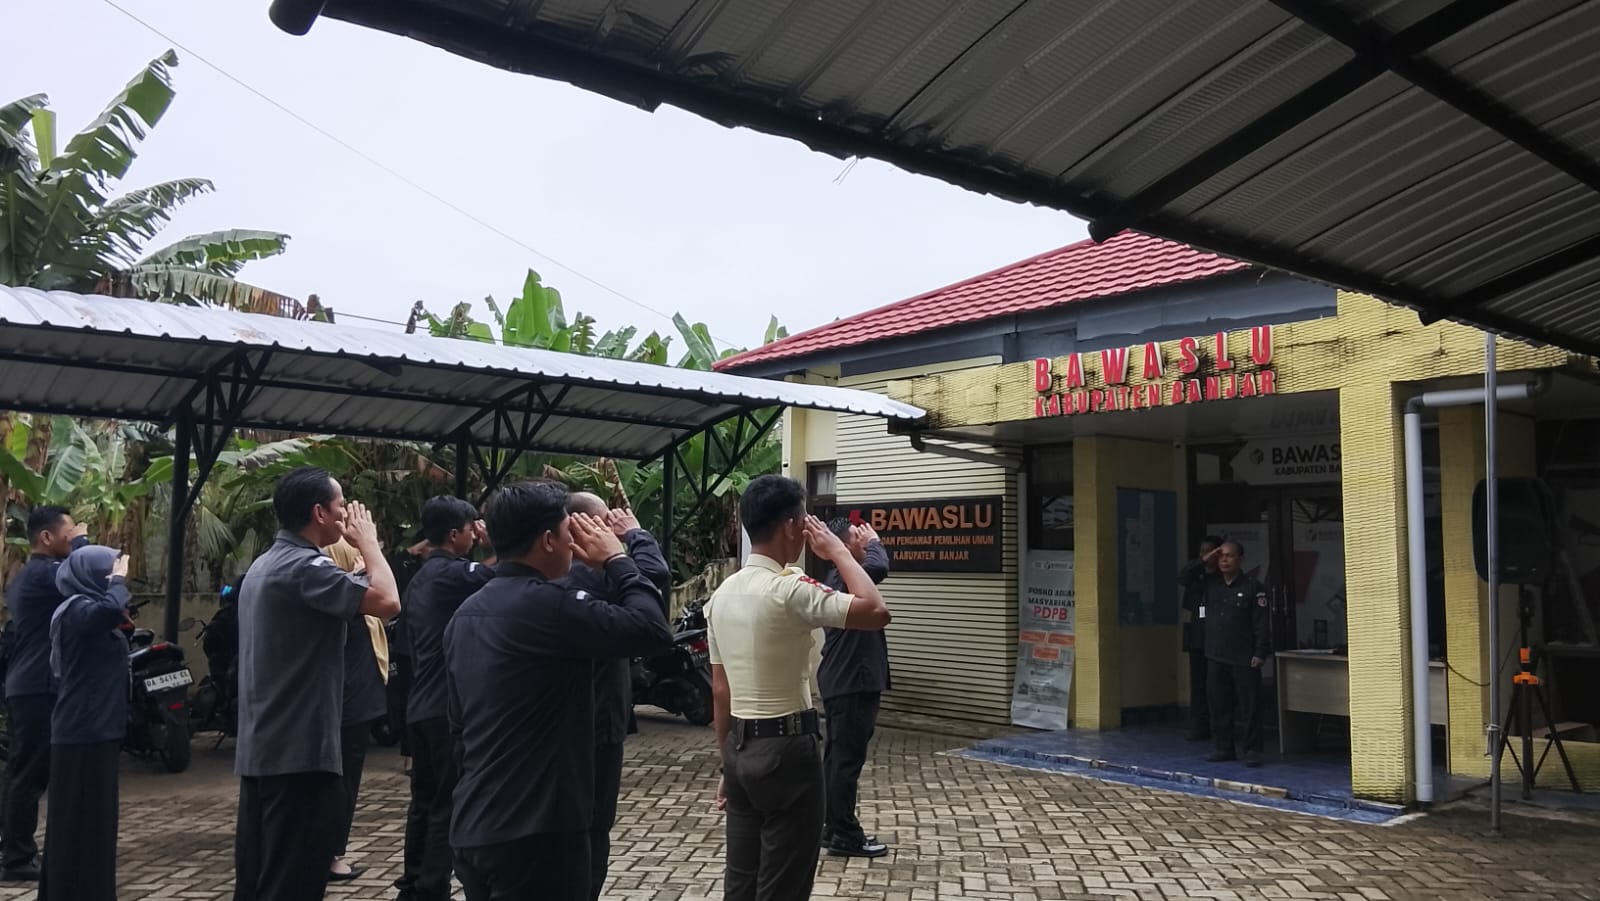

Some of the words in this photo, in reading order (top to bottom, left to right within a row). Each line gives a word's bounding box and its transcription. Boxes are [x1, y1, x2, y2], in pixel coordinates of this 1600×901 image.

[1034, 324, 1275, 392] BAWASLU
[1034, 383, 1163, 418] KABUPATEN
[1171, 369, 1277, 405] BANJAR
[1271, 443, 1340, 465] BAWAS
[1274, 464, 1327, 476] KABUPATEN
[1328, 463, 1340, 473] BA
[872, 504, 992, 531] BAWASLU
[881, 536, 896, 546] DAN
[897, 536, 933, 546] PENGAWAS
[934, 535, 971, 545] PEMILIHAN
[972, 535, 994, 545] UMUM
[893, 551, 935, 561] KABUPATEN
[939, 550, 970, 561] BANJAR
[1033, 605, 1068, 621] PDPB
[146, 679, 155, 687] DA
